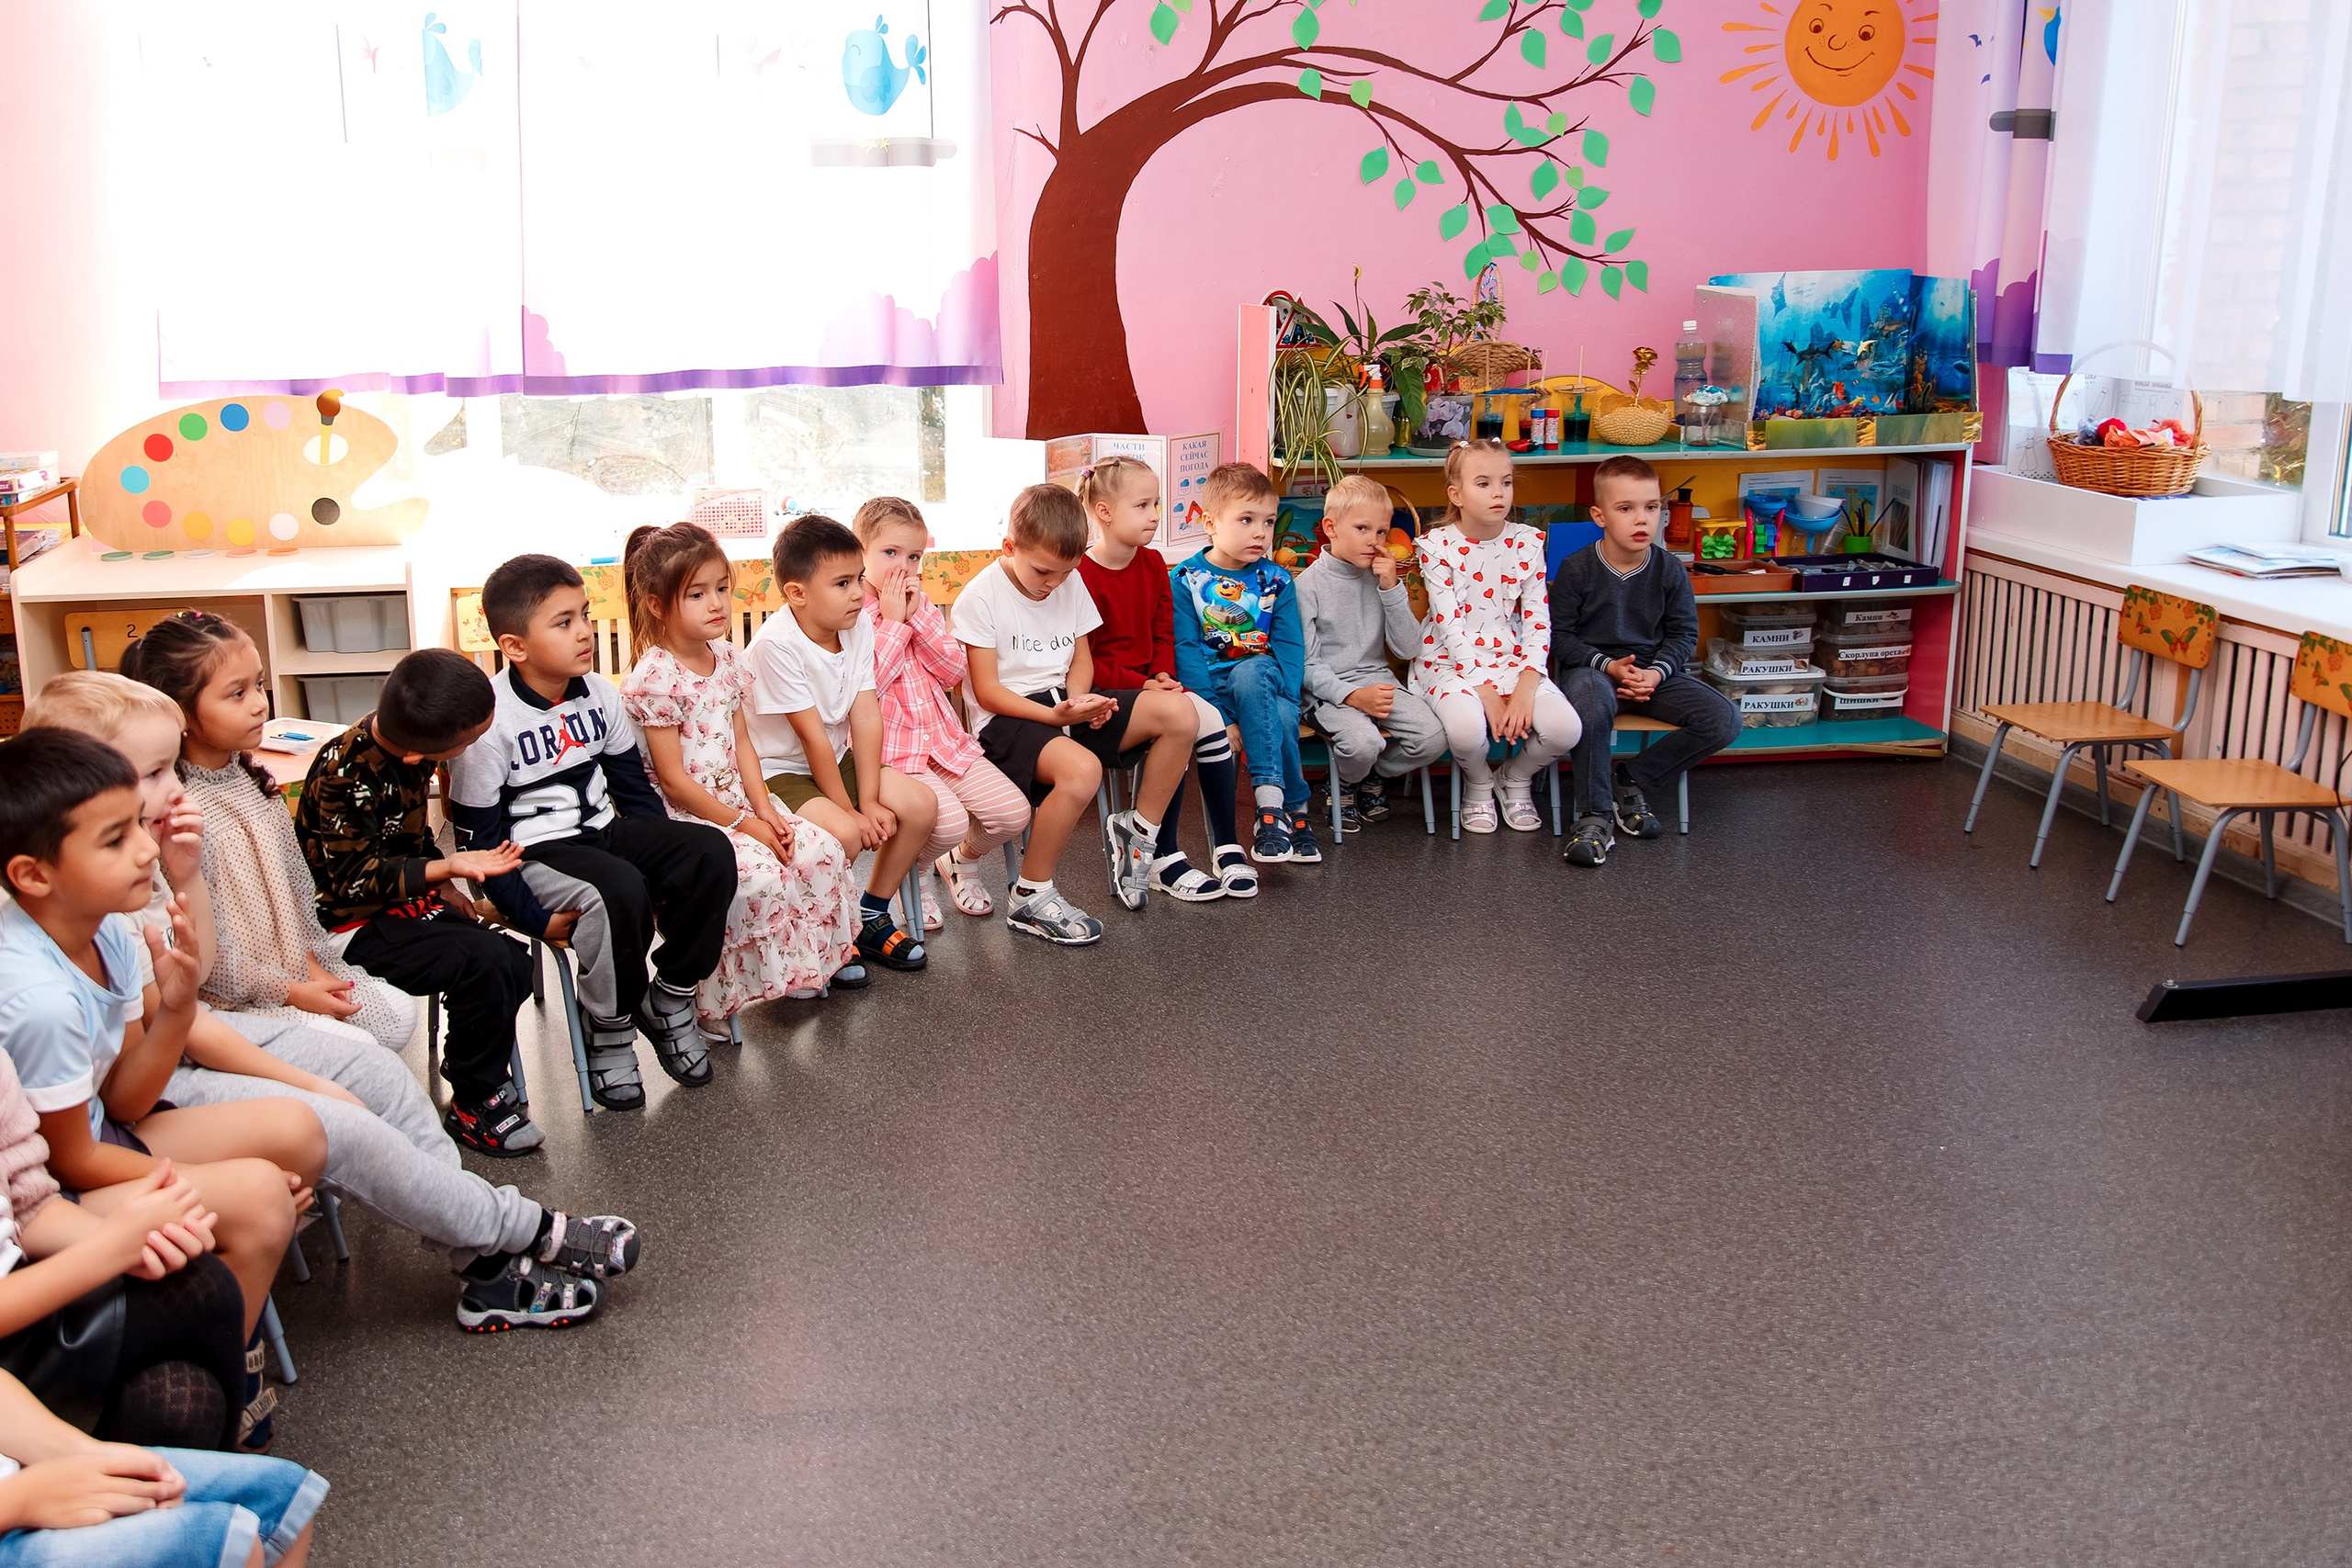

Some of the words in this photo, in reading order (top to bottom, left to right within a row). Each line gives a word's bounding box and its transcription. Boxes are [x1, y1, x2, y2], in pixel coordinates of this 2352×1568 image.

[1114, 442, 1146, 451] ЧАСТИ
[1182, 440, 1207, 451] КАКАЯ
[1180, 451, 1209, 462] СЕЙЧАС
[1180, 462, 1209, 472] ПОГОДА
[1855, 614, 1883, 622] Камни
[127, 624, 139, 637] 2
[1012, 635, 1043, 652] Nice
[1752, 635, 1790, 643] КАМНИ
[1838, 650, 1879, 660] Скорлупа
[1880, 649, 1902, 658] ореха
[1742, 664, 1792, 673] РАКУШКИ
[1744, 700, 1794, 709] РАКУШКИ
